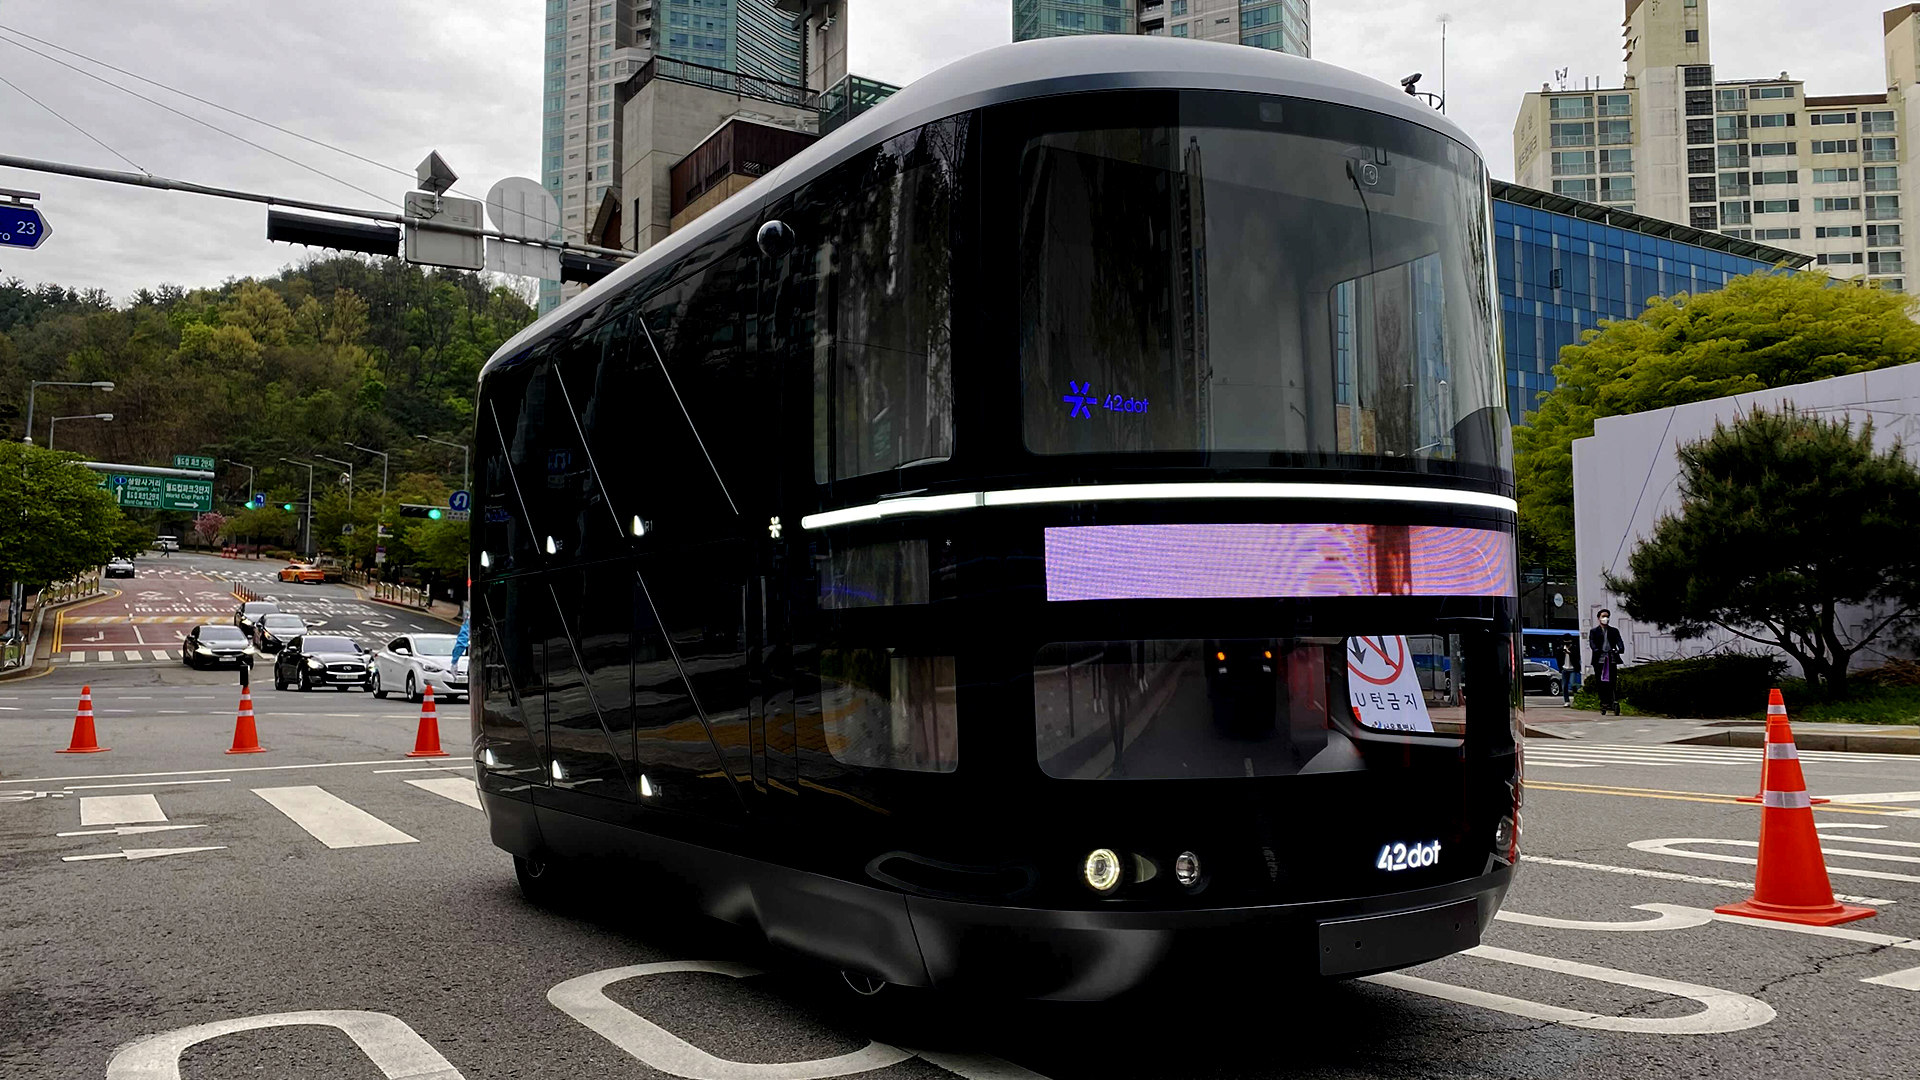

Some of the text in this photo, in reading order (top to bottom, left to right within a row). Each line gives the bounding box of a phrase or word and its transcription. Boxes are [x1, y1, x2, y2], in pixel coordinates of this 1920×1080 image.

[16, 221, 36, 235] 23
[1103, 393, 1149, 413] 42dot
[128, 477, 161, 487] 상암사거리
[166, 483, 210, 495] 월드컵파크3단지
[645, 520, 653, 533] R1
[1377, 839, 1442, 872] 42dot
